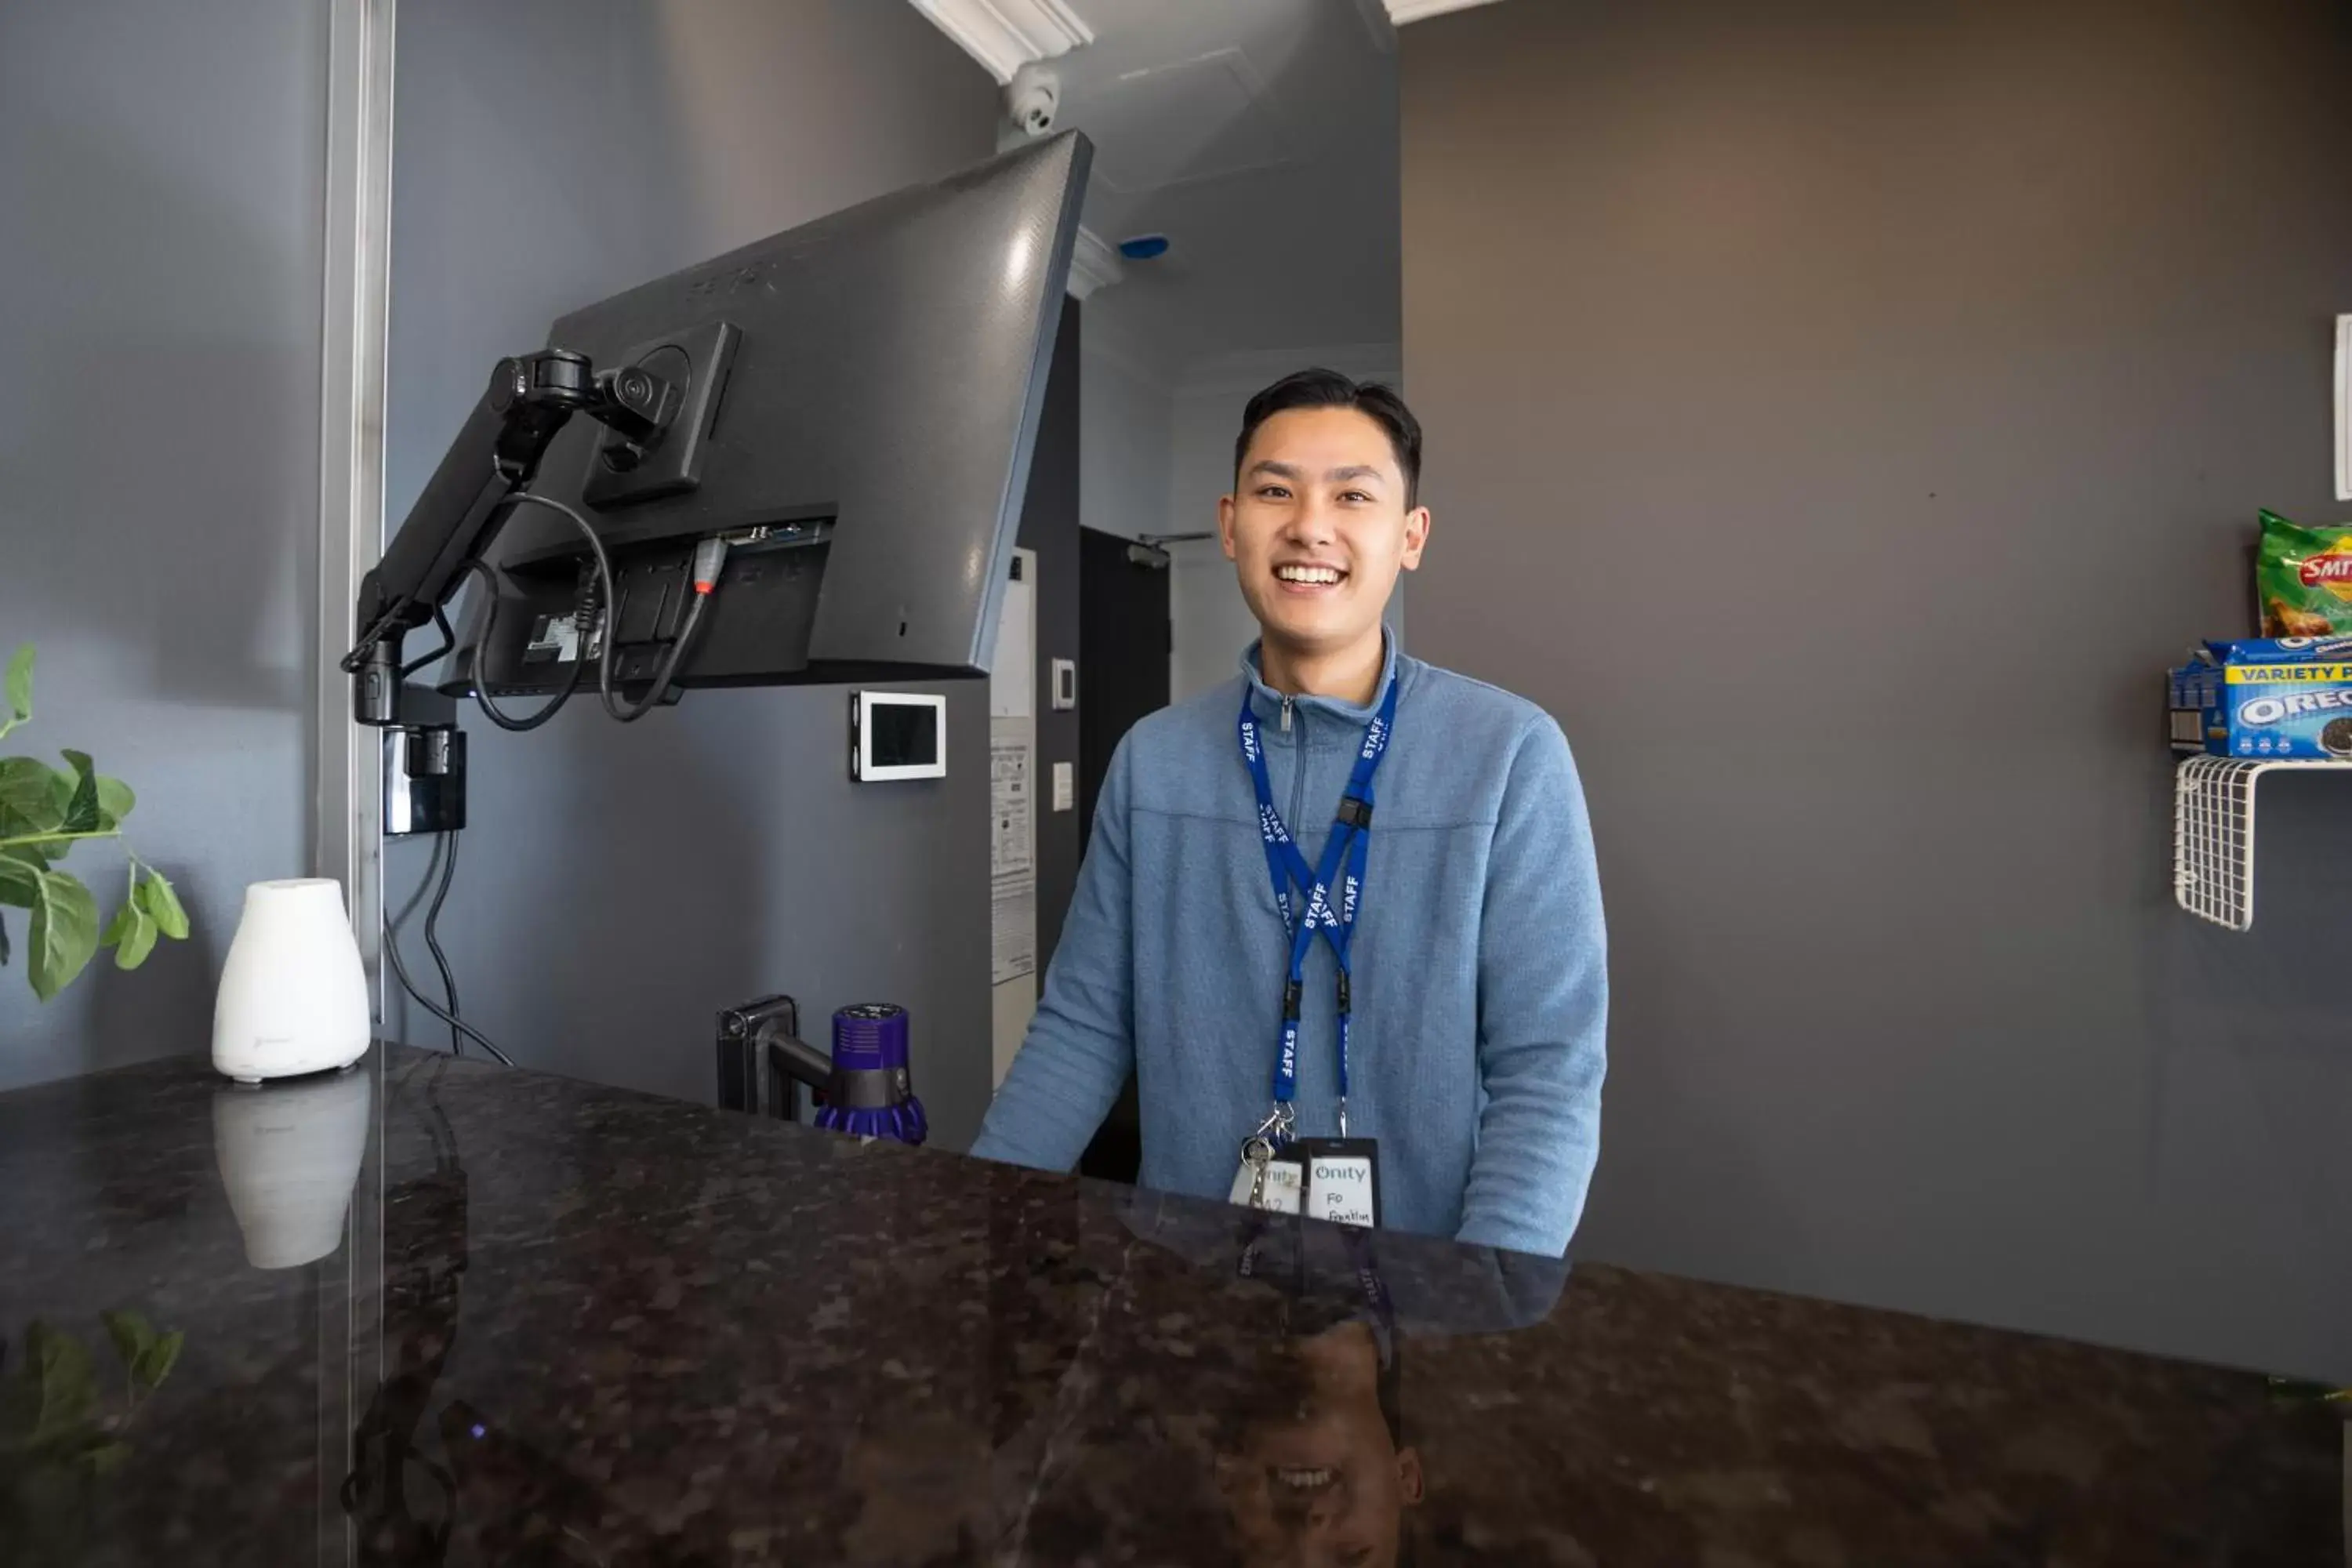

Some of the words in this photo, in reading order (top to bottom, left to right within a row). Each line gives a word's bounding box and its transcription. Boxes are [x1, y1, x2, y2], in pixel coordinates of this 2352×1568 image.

[2303, 558, 2352, 577] SMI
[2240, 666, 2335, 681] VARIETY
[1242, 722, 1255, 762] STAFF
[1362, 717, 1384, 760] STAFF
[1304, 882, 1327, 929] STAFF
[1343, 875, 1359, 923] STAFF
[1282, 1029, 1295, 1078] STAFF
